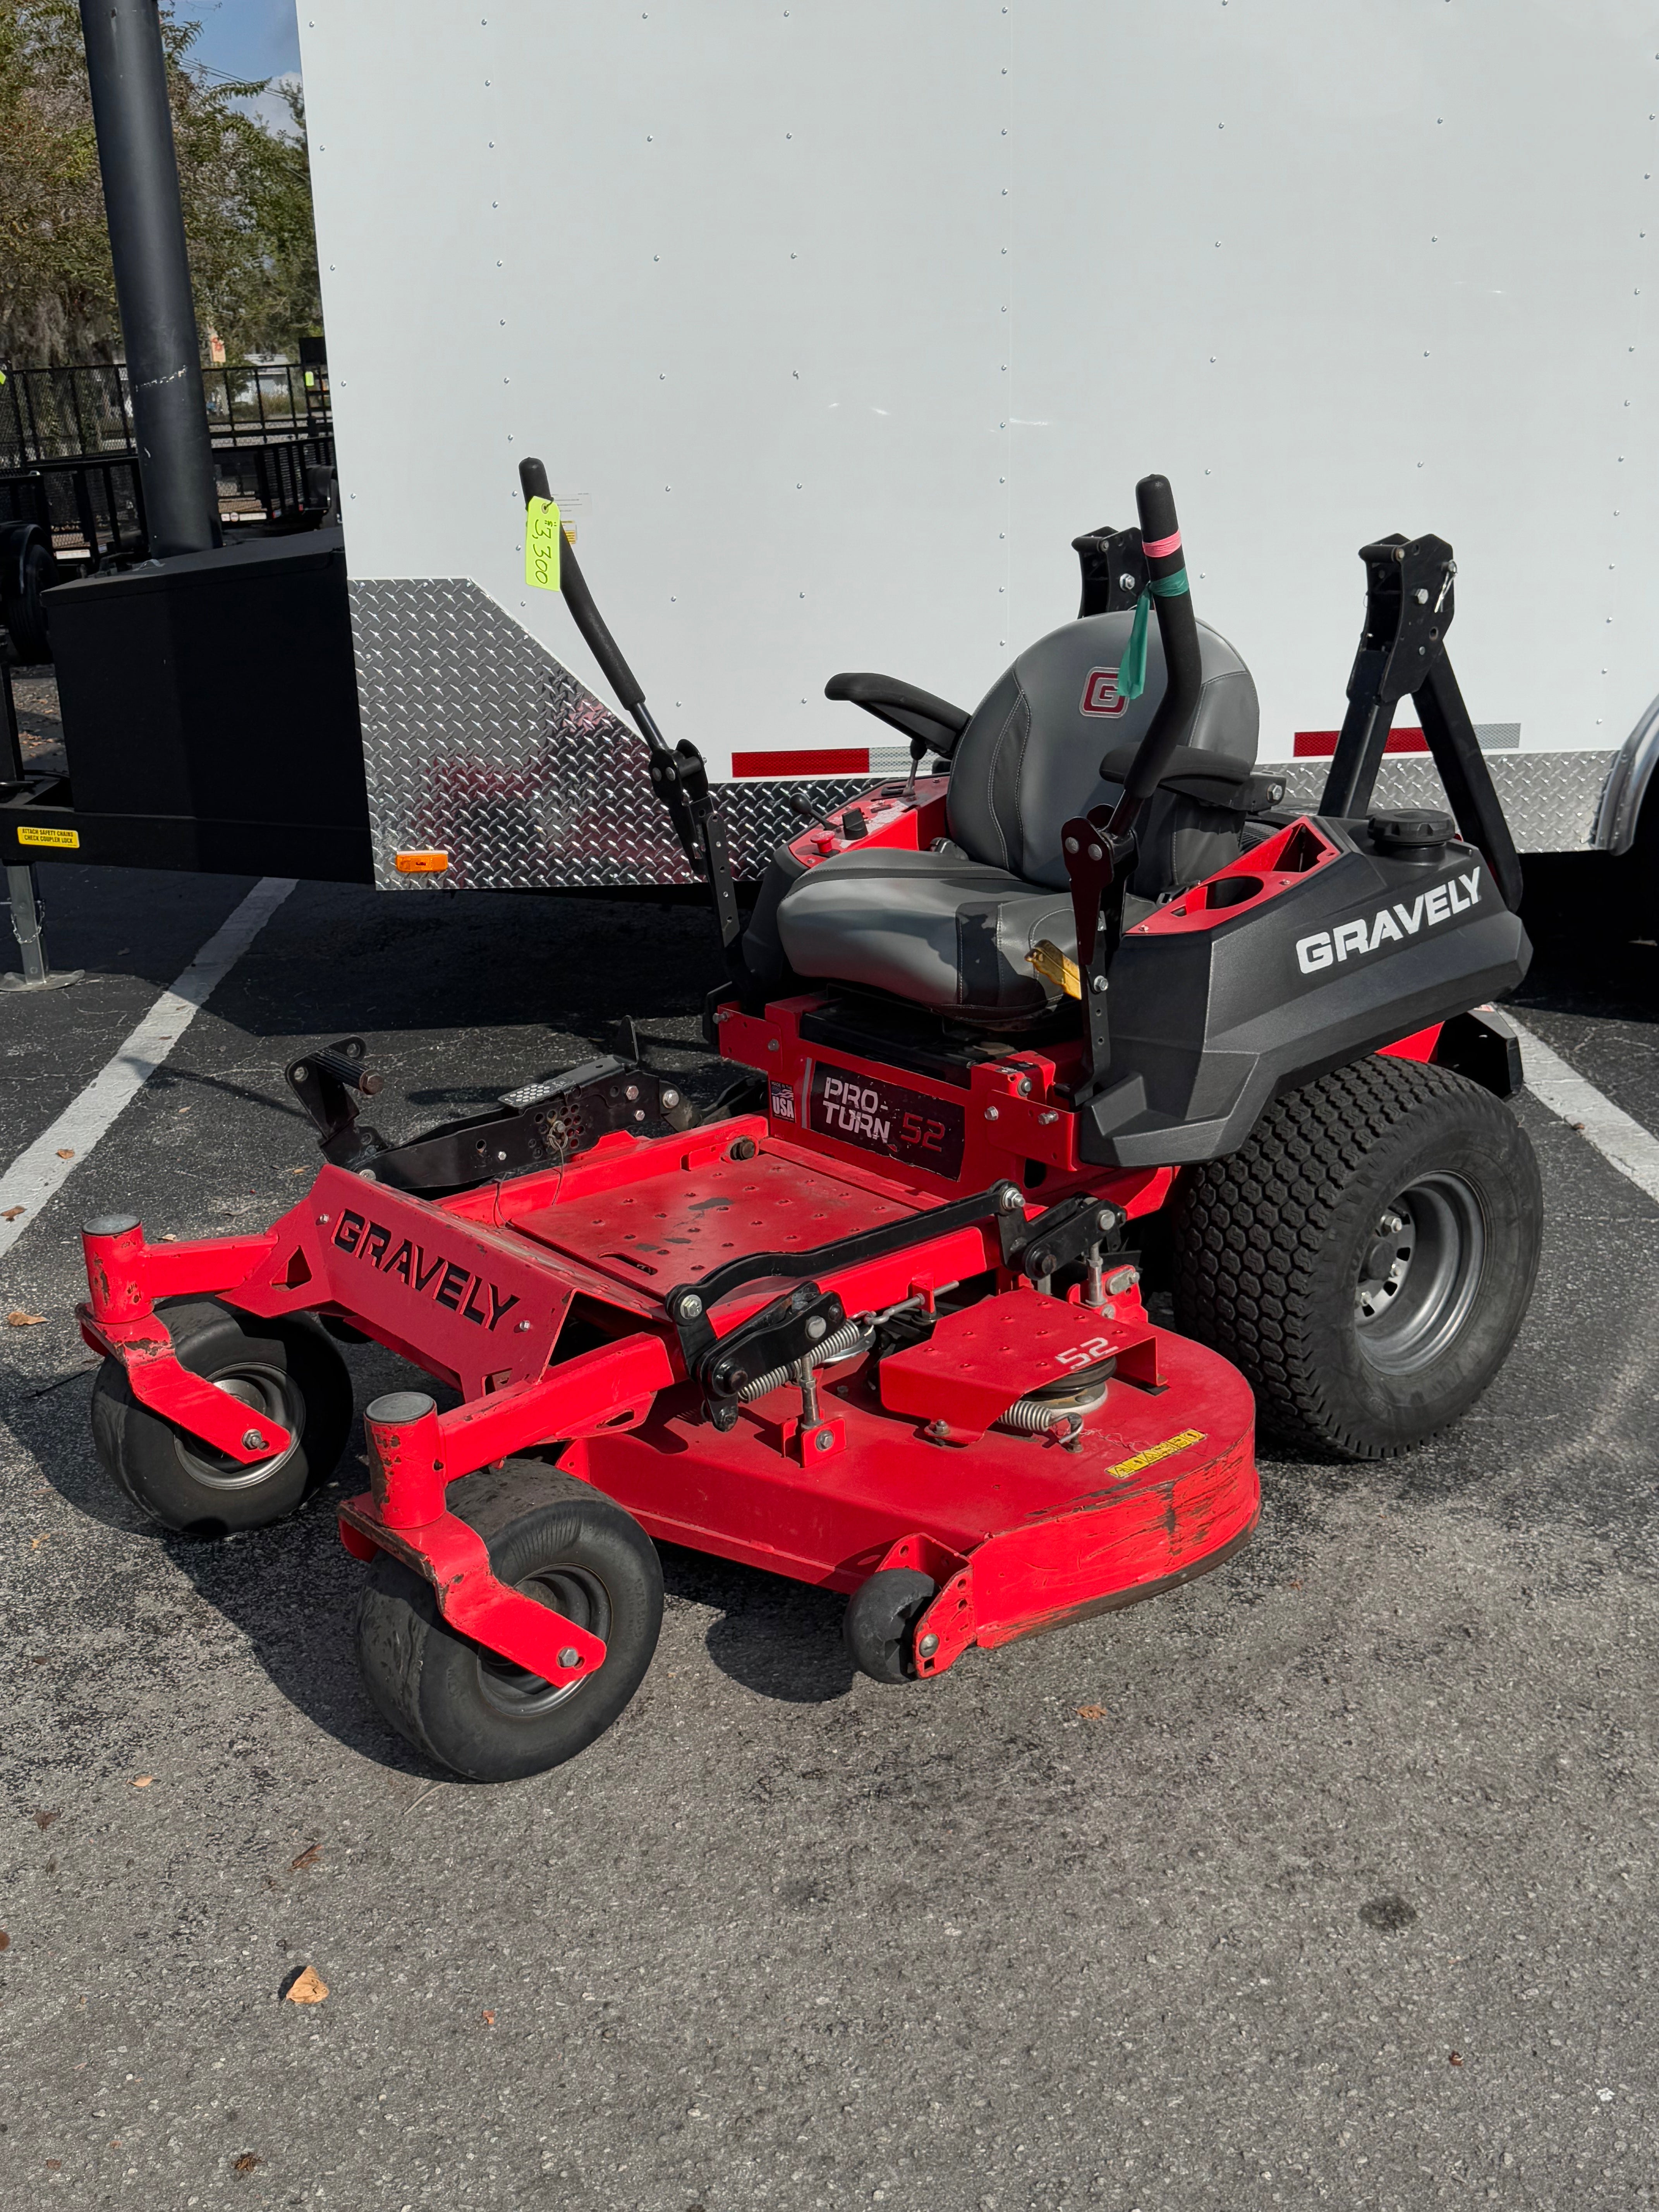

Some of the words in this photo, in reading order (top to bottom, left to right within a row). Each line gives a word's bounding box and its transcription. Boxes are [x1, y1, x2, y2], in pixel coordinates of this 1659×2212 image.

[1296, 866, 1480, 974] GRAVELY
[772, 1095, 794, 1119] USA
[824, 1077, 888, 1114] PRO-
[823, 1100, 890, 1144] TURN
[900, 1111, 946, 1152] 52
[331, 1208, 521, 1332] GRAVELY
[1054, 1337, 1119, 1370] 52
